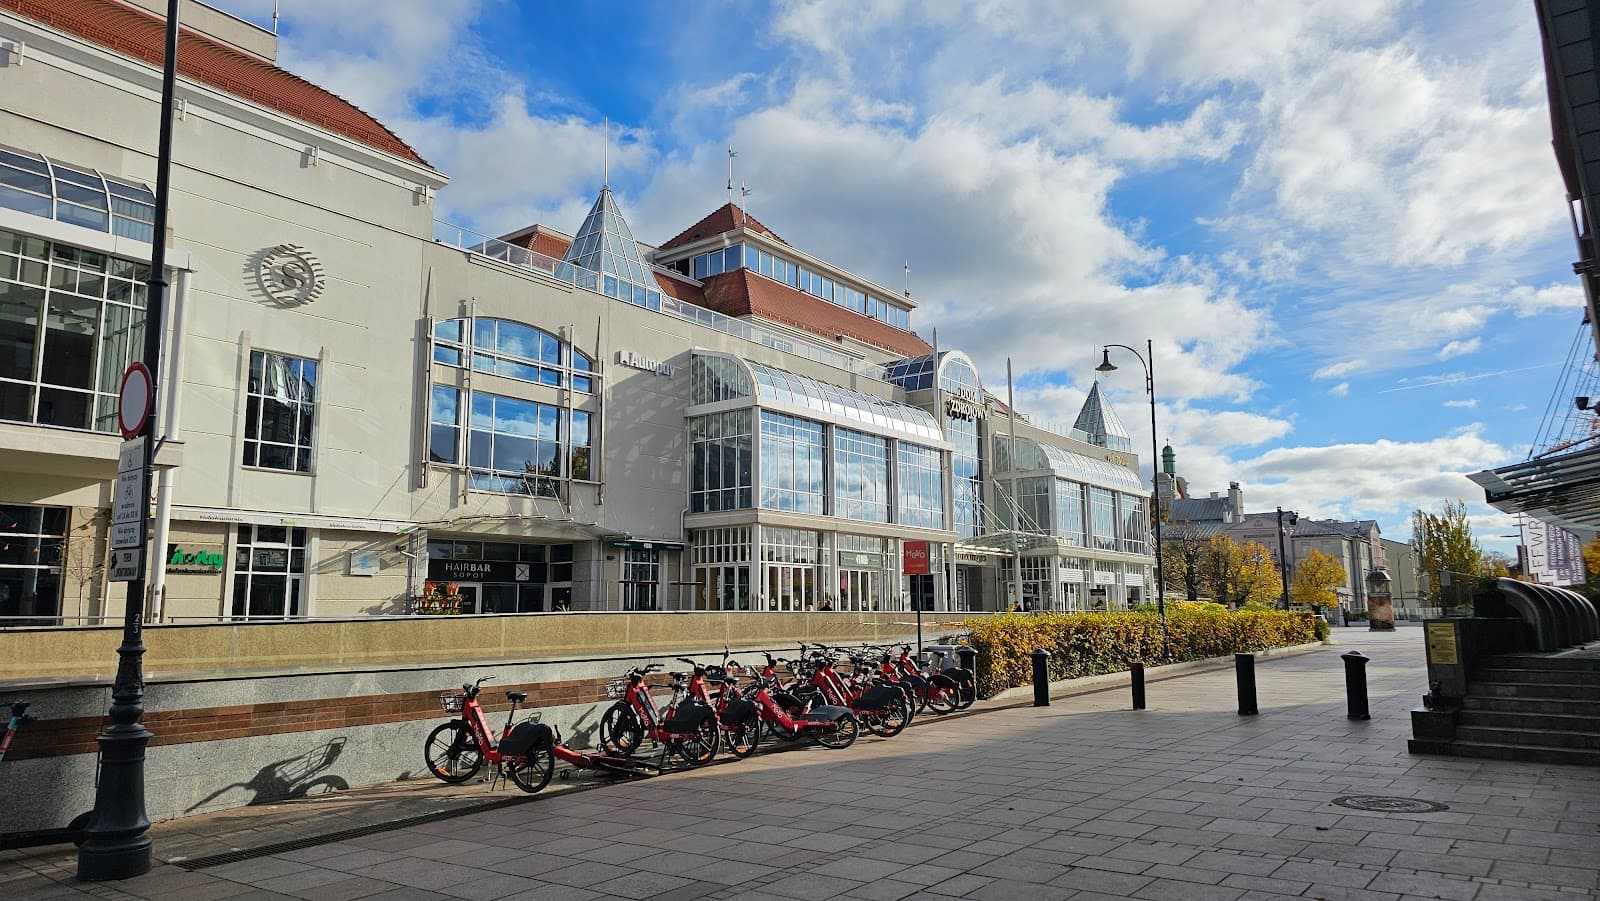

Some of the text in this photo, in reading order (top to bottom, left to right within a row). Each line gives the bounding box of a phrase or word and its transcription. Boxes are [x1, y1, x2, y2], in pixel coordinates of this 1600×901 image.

[957, 386, 976, 402] DOM
[949, 399, 988, 421] ZDROJOWY
[445, 562, 491, 572] HAIRBAR
